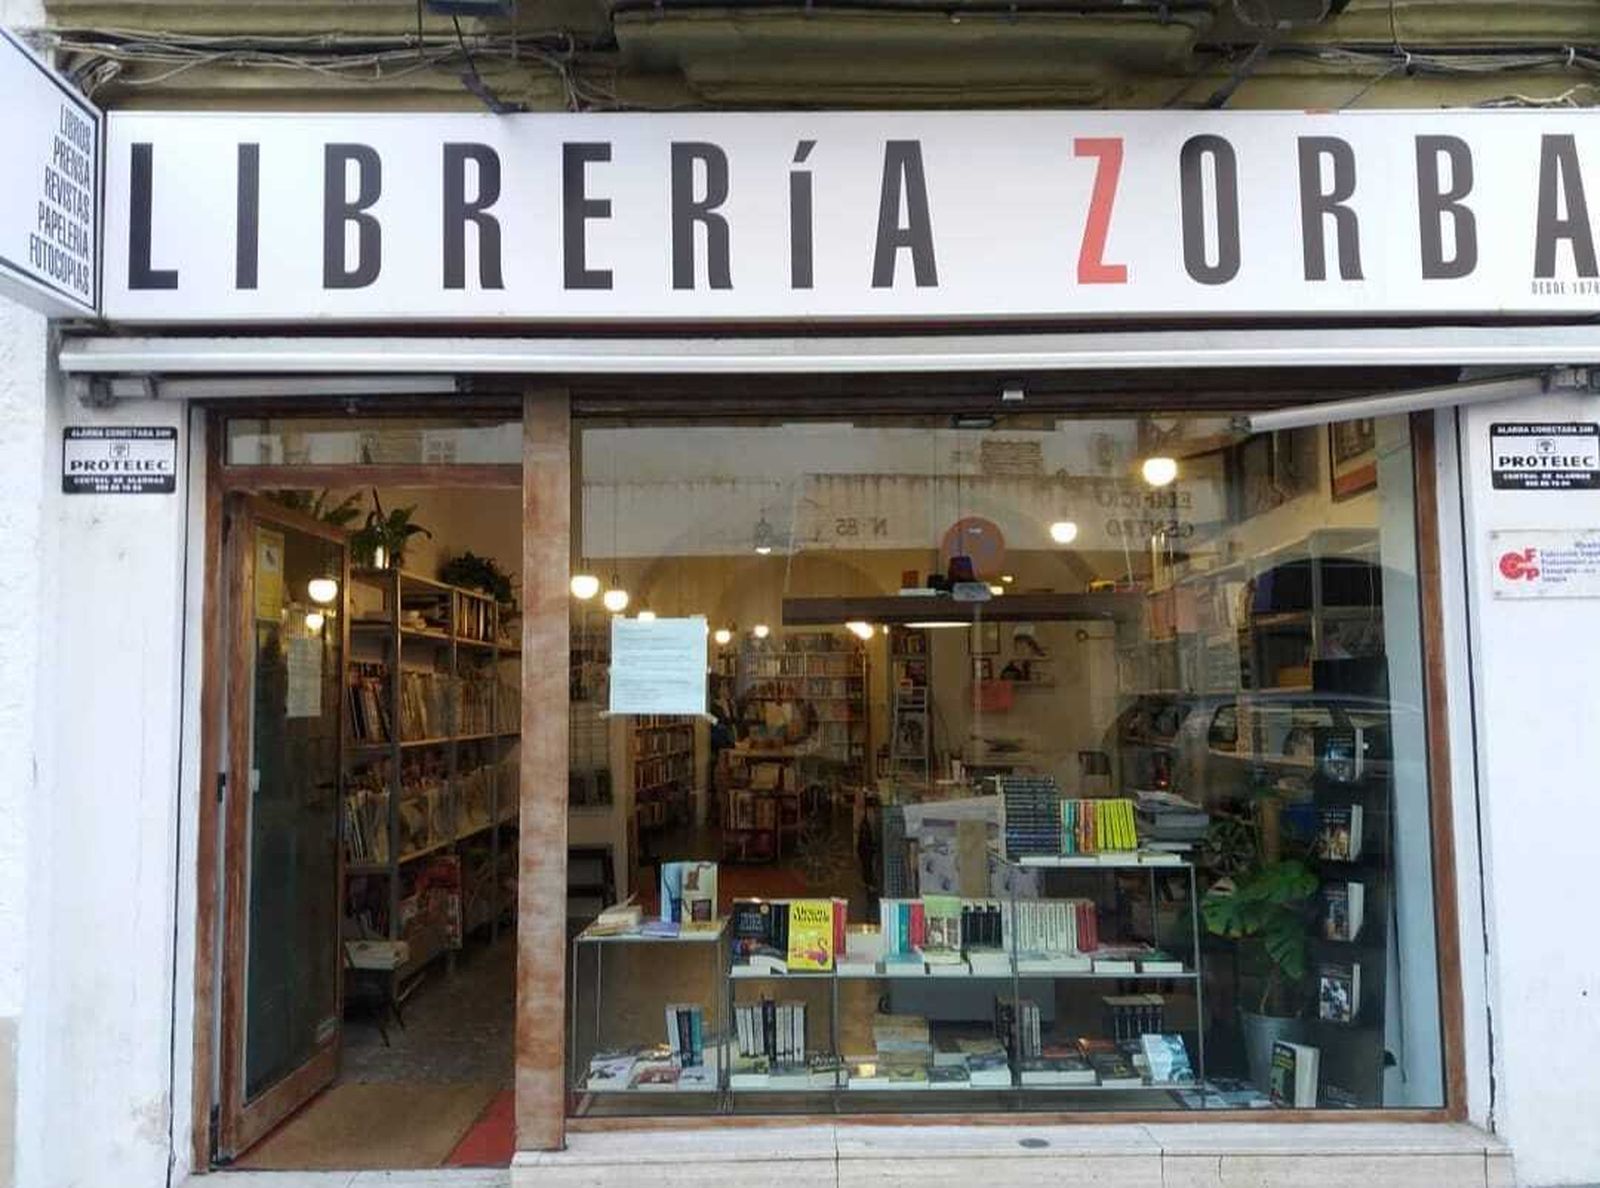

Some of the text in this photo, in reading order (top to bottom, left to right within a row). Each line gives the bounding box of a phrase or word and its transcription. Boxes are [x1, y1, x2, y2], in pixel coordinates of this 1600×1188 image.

[60, 104, 91, 156] LIBROS
[53, 135, 91, 192] PRENSA
[45, 167, 90, 225] REVISTAS
[1073, 133, 1600, 286] ZORBA
[29, 232, 90, 297] FOTOCOPIAS
[70, 459, 169, 471] PROTELEC
[1498, 456, 1595, 468] PROTELEC
